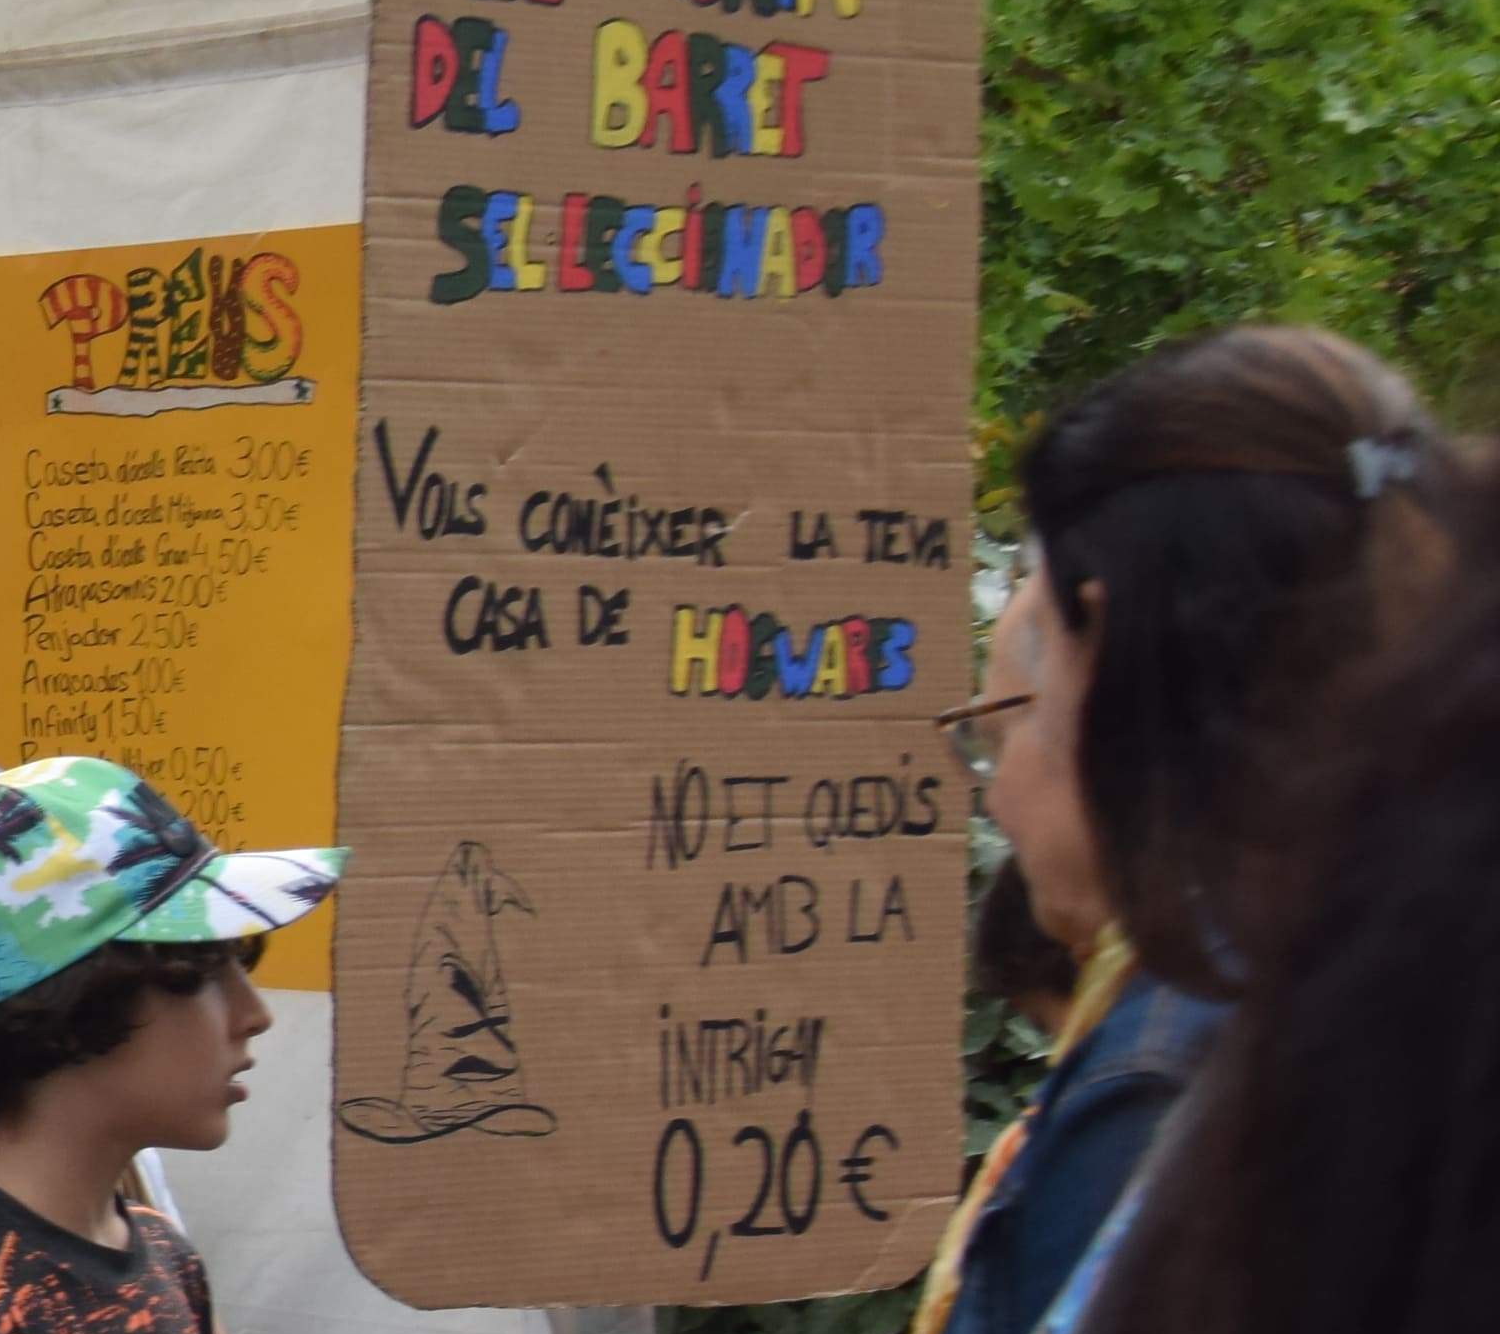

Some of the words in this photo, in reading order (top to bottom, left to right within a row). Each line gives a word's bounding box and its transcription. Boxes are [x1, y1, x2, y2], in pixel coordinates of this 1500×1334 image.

[410, 14, 520, 136] DEL
[592, 18, 830, 157] BARRET
[38, 247, 304, 389] PREUS
[24, 448, 110, 489] Caseta
[373, 417, 488, 541] VOLS
[790, 510, 838, 559] LA
[858, 509, 950, 570] TEVA
[24, 491, 100, 529] Caseta
[28, 531, 94, 571] Caseta
[23, 613, 122, 661] Penjador
[444, 575, 551, 654] CASA
[579, 584, 631, 646] DE
[21, 659, 129, 695] Arracades
[23, 701, 96, 742] Infinity
[646, 757, 709, 870] NO
[722, 776, 790, 852] ET
[700, 874, 820, 967] AMB
[846, 874, 915, 943] LA
